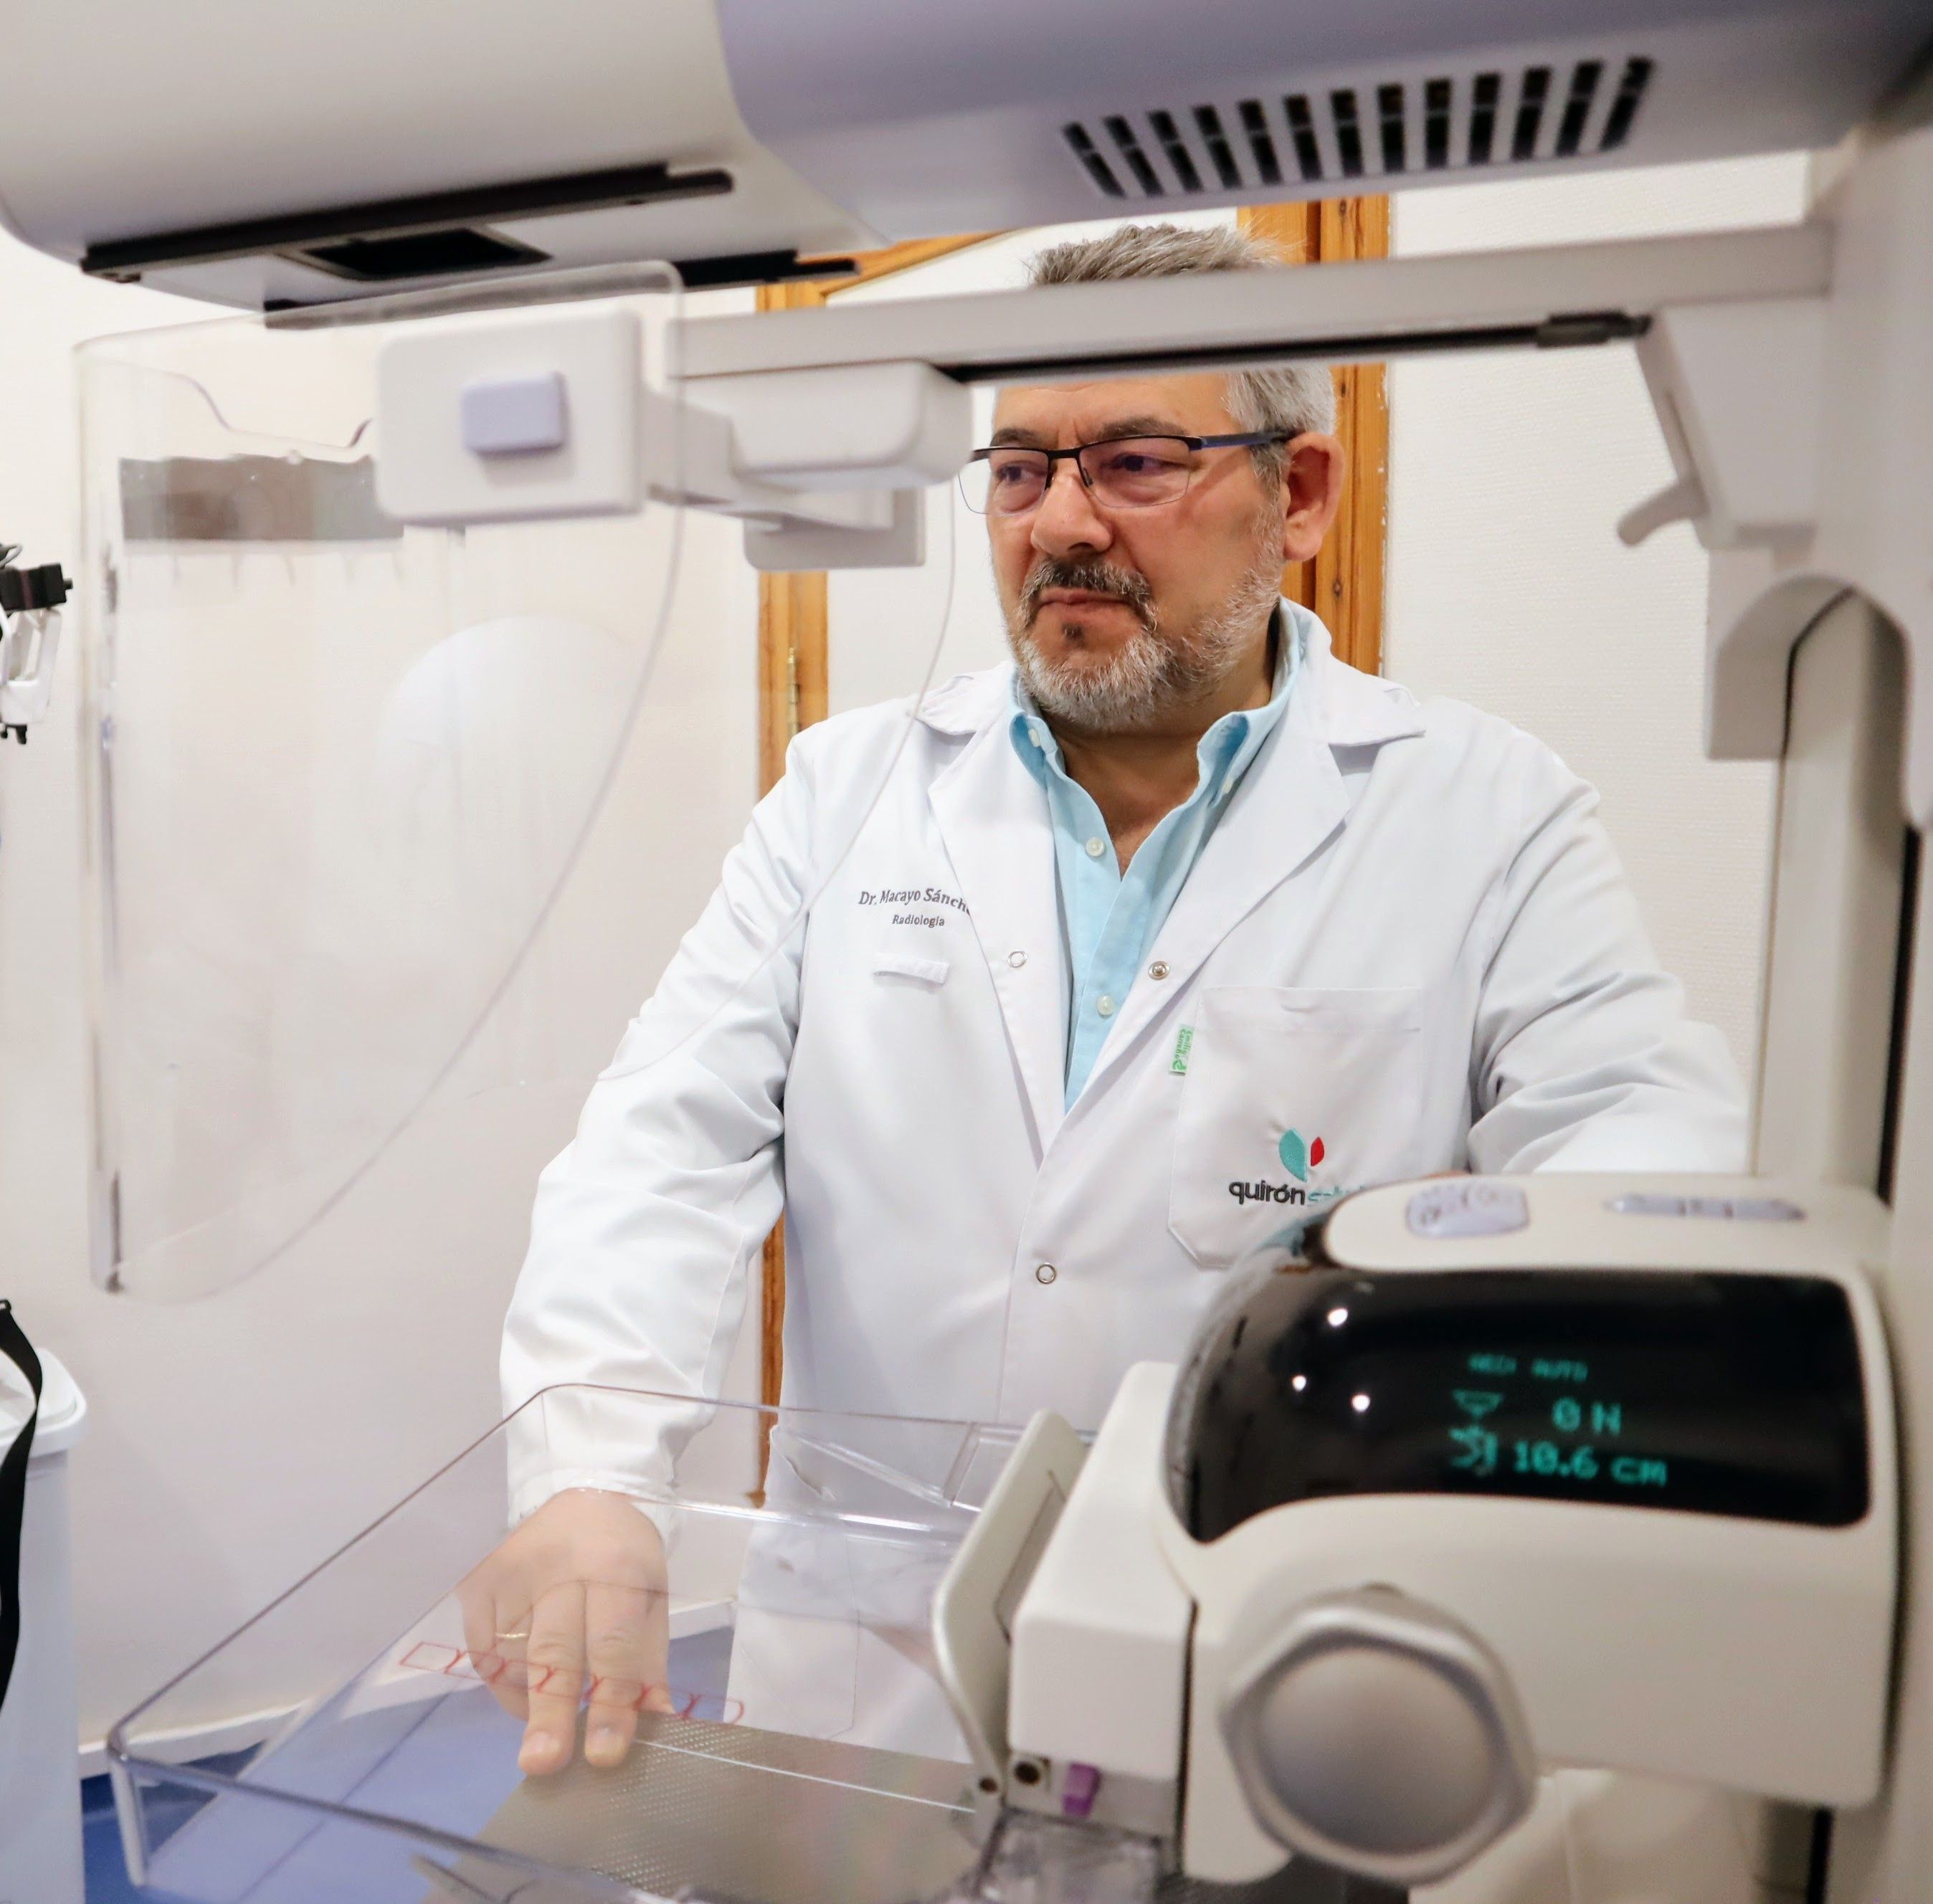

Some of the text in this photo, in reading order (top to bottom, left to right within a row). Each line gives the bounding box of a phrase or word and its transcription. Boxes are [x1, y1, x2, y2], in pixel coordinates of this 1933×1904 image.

[858, 890, 877, 905] Dr.
[880, 889, 921, 905] Macayo
[1552, 1396, 1581, 1432] 0
[1514, 1440, 1599, 1480] 10.6
